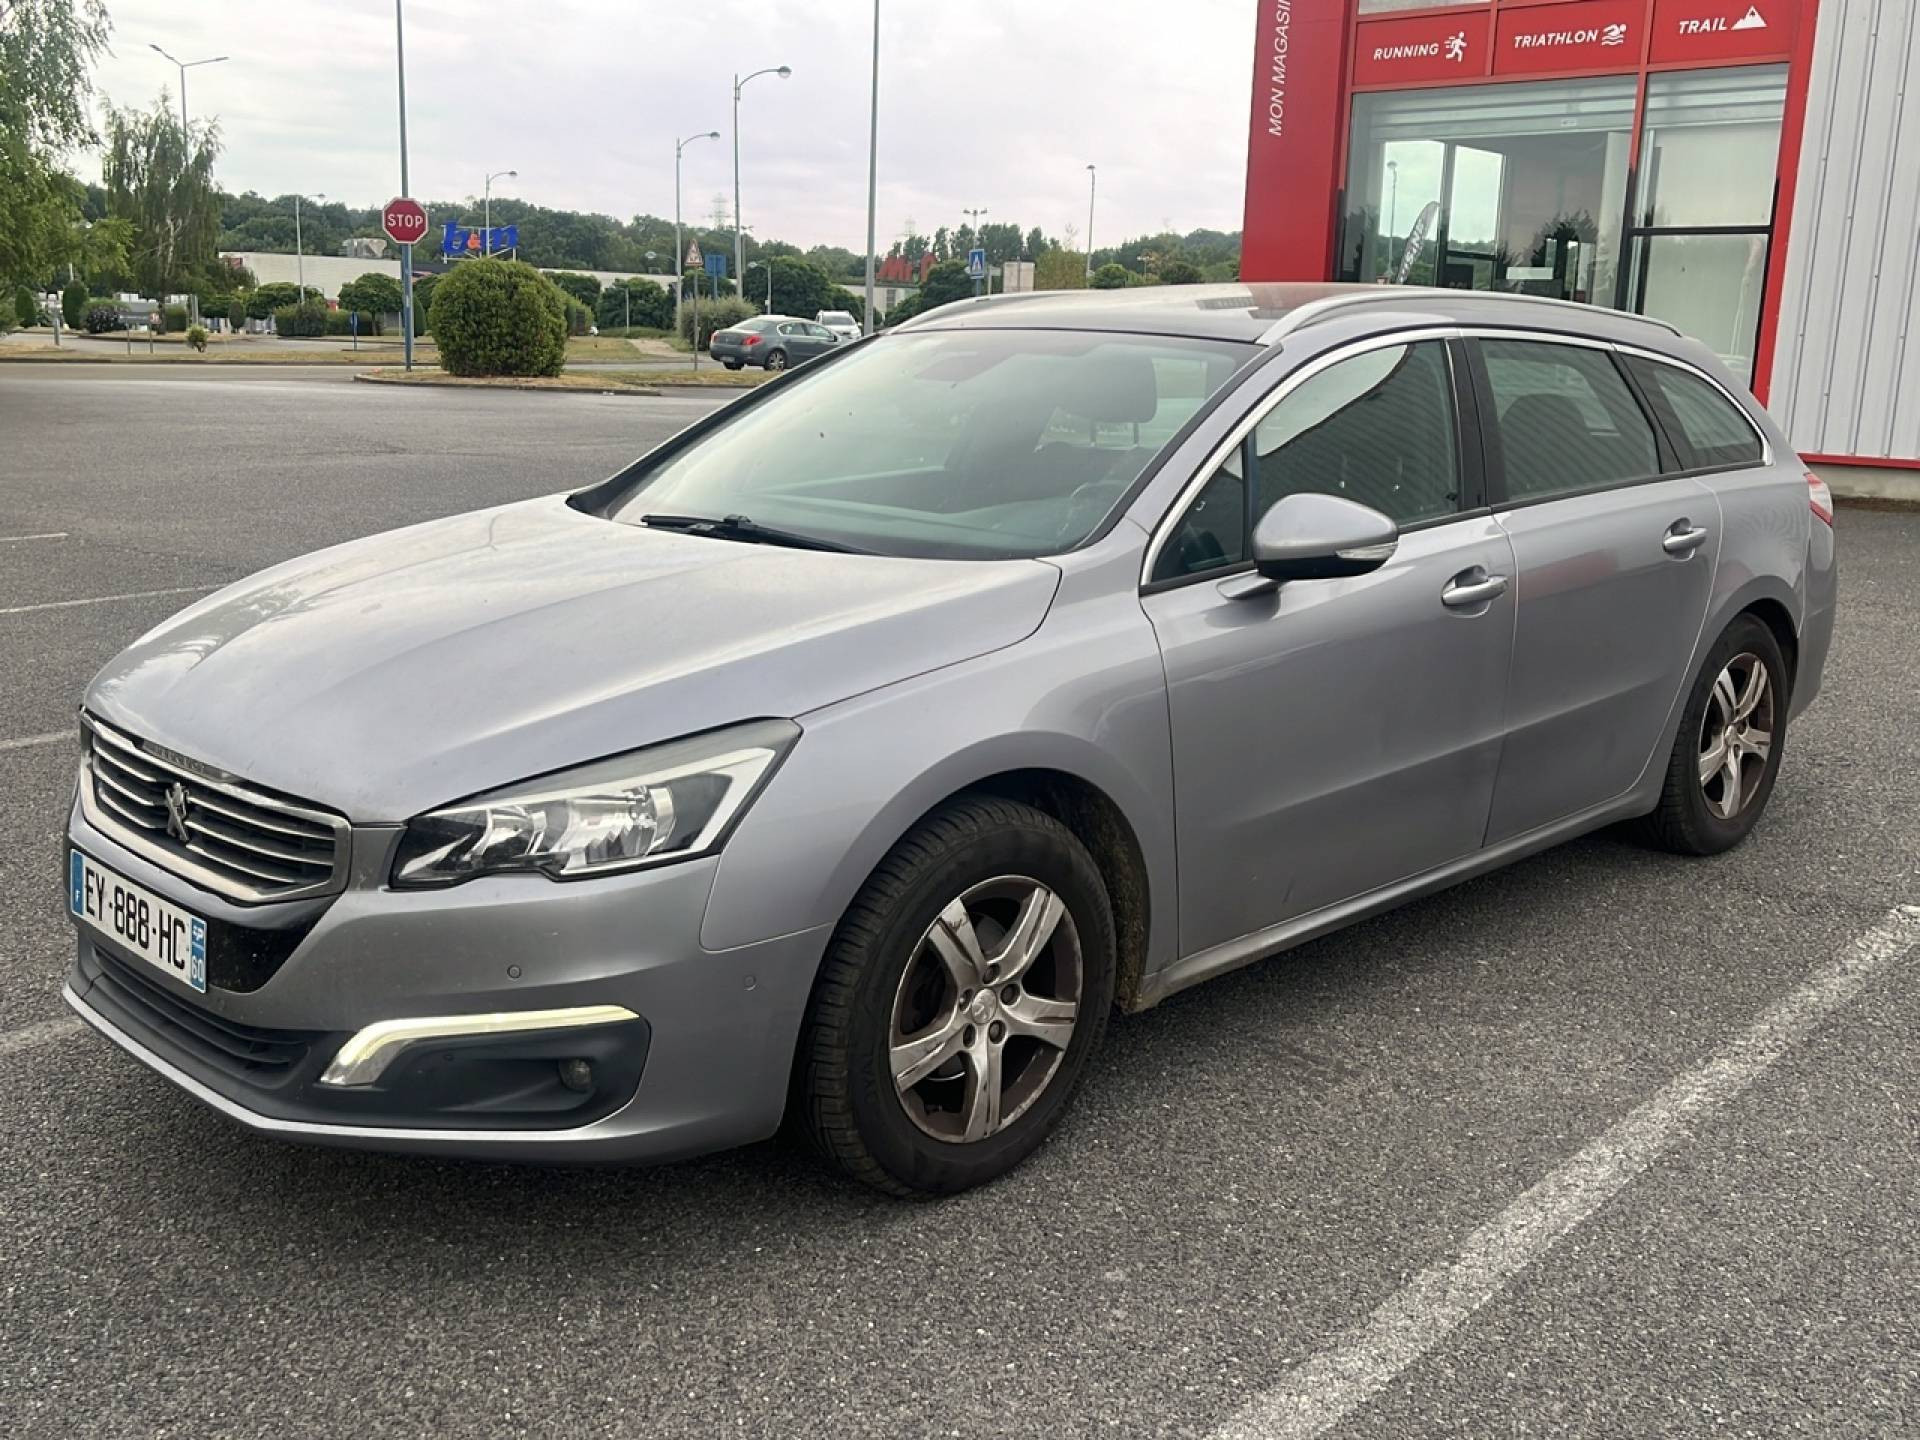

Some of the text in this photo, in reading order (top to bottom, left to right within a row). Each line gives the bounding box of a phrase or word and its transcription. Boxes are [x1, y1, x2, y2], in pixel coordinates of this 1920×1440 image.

[1679, 17, 1727, 35] TRAIL
[1514, 29, 1599, 49] TRIATHLON
[1373, 43, 1439, 61] RUNNING
[1268, 87, 1285, 136] MON
[387, 213, 424, 228] STOP
[191, 955, 205, 983] 60
